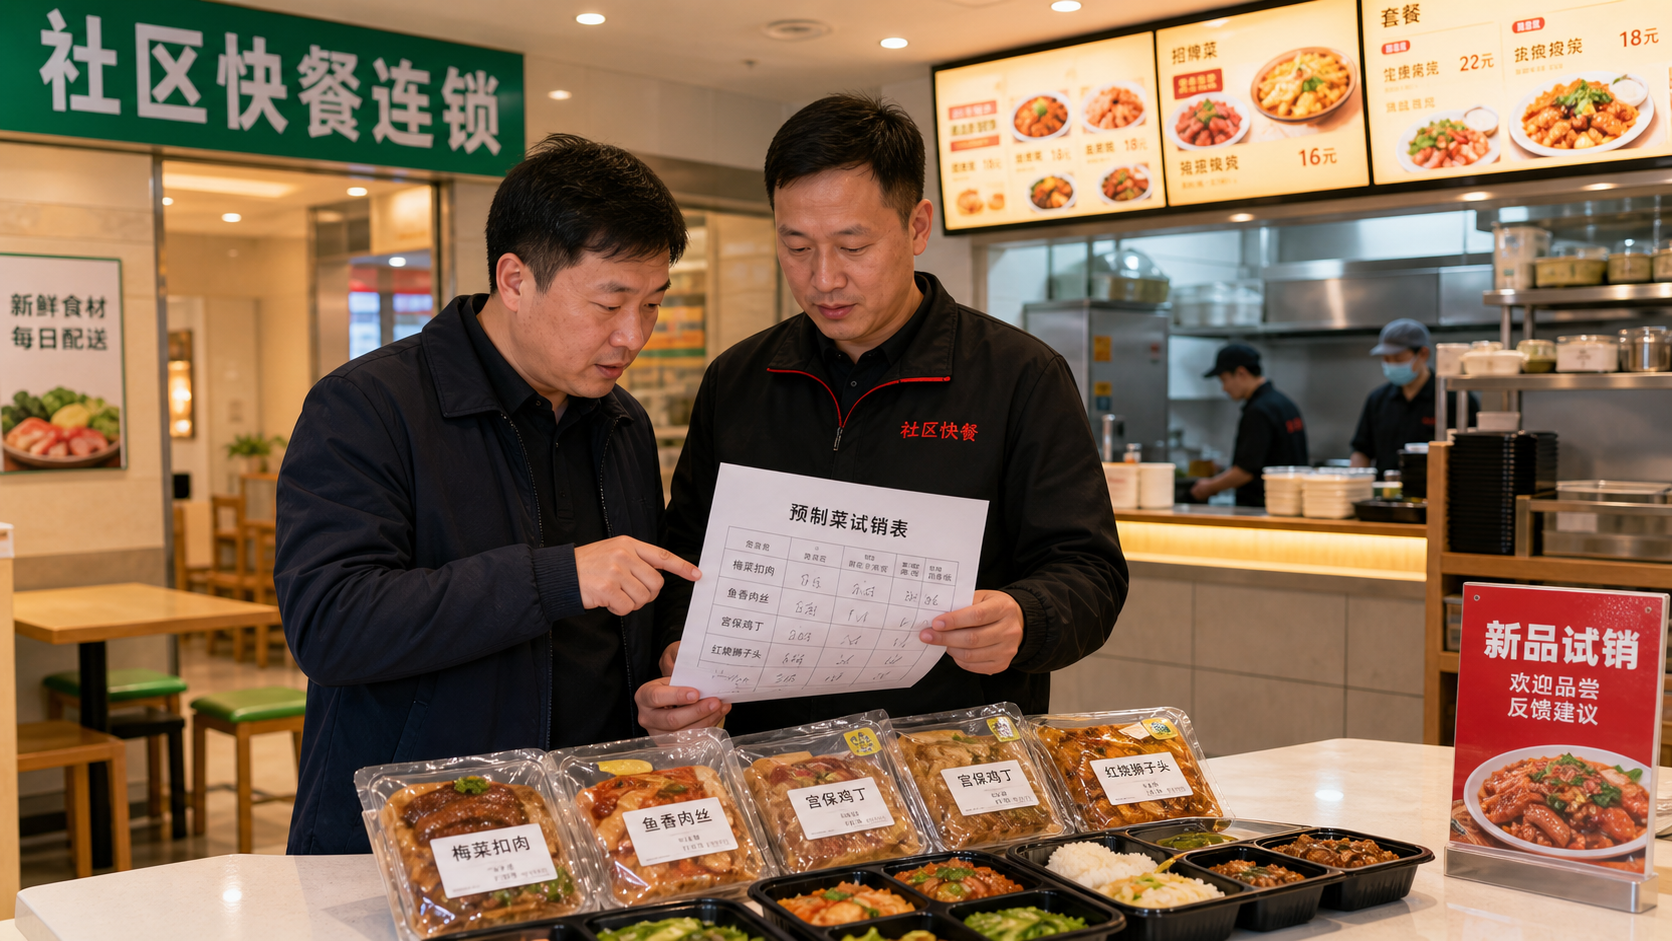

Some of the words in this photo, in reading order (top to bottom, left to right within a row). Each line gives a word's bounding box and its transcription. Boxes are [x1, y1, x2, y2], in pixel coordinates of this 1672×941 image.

[1380, 3, 1421, 28] 套餐
[1619, 27, 1659, 48] 18元
[1171, 42, 1217, 65] 招牌菜
[1459, 53, 1495, 72] 22元
[39, 8, 502, 156] 社区快餐连锁
[1299, 147, 1338, 167] 16元
[10, 293, 107, 319] 新鲜食材
[10, 326, 108, 351] 每日配送
[900, 420, 979, 442] 社区快餐
[788, 503, 909, 538] 预制菜试销表
[732, 559, 775, 577] 梅菜扣肉
[727, 587, 769, 604] 鱼香肉丝
[721, 616, 764, 631] 宫保鸡丁
[1483, 620, 1640, 670] 新品试销
[1509, 672, 1600, 700] 欢迎品尝
[1507, 697, 1599, 726] 反馈建议
[957, 769, 1011, 788] 宫保鸡丁
[805, 787, 866, 809] 宫保鸡丁
[642, 808, 712, 832] 鱼香肉丝
[452, 835, 530, 861] 梅菜扣肉
